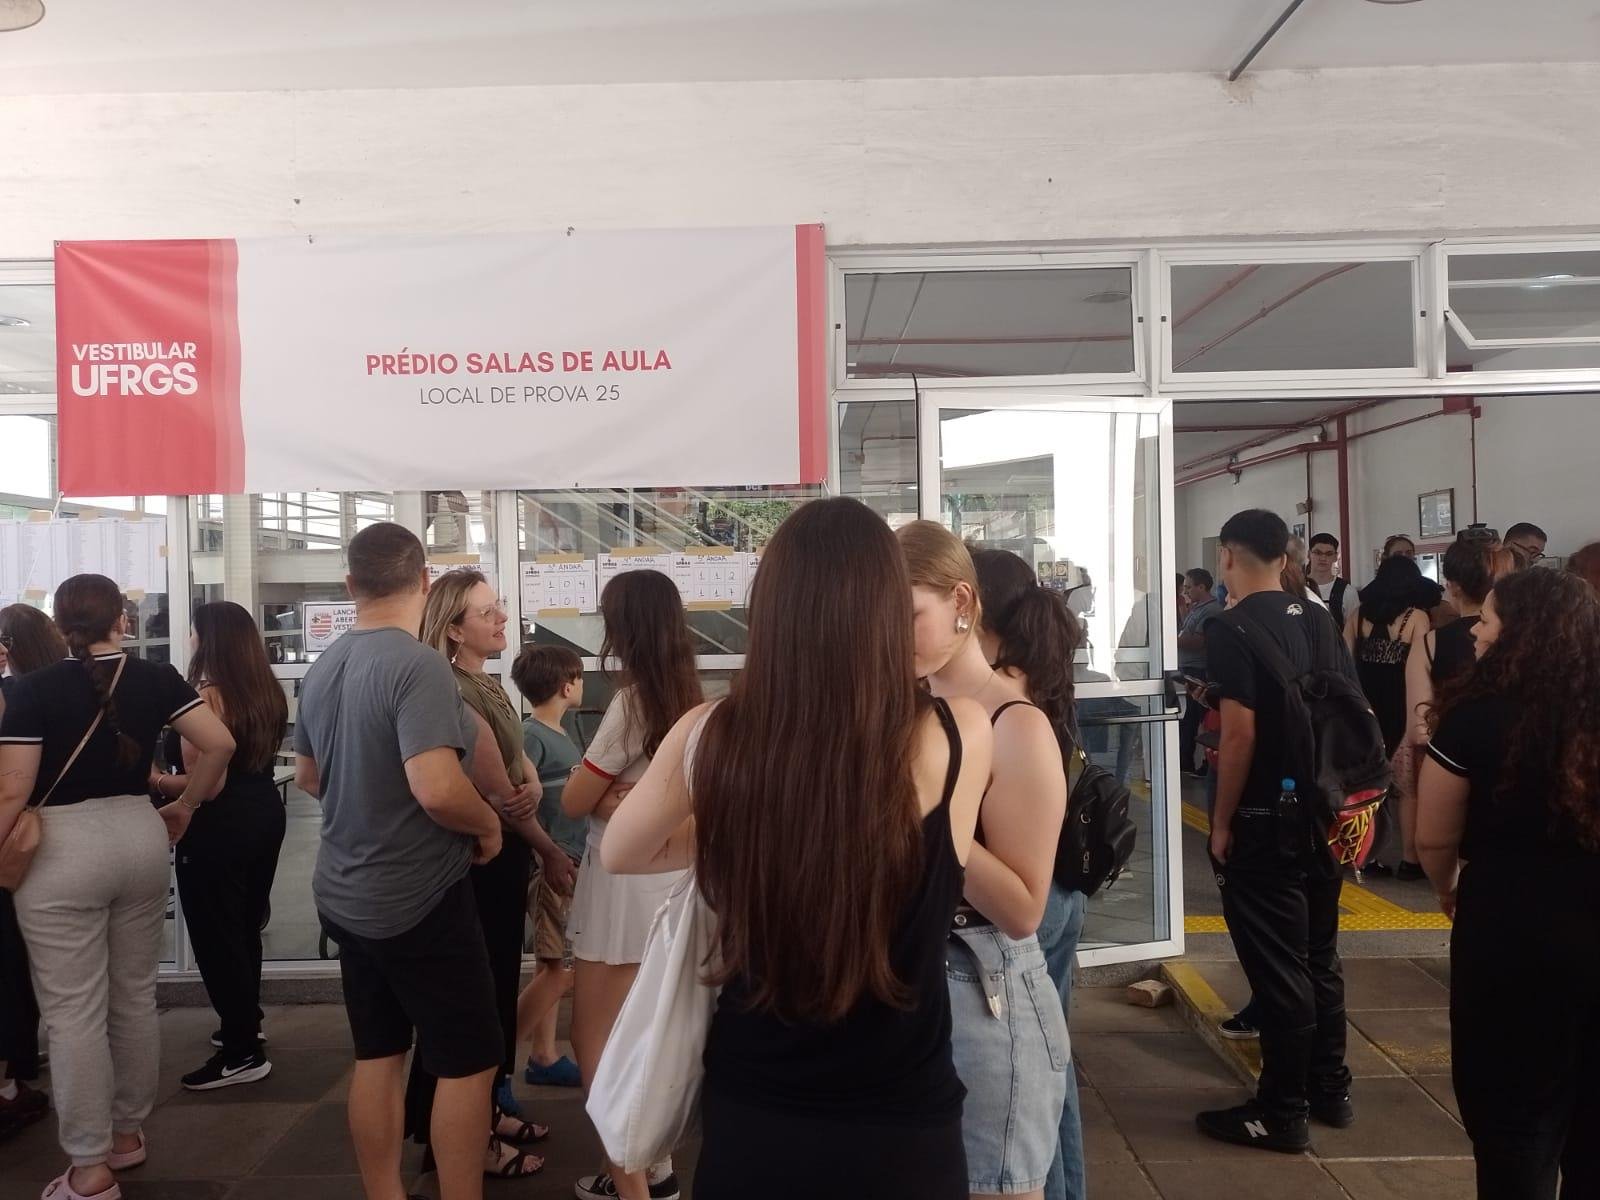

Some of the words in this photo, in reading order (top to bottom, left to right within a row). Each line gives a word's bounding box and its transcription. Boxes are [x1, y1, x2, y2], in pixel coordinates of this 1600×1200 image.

[71, 342, 197, 361] VESTIBULAR
[366, 347, 458, 375] PRÉDIO
[466, 352, 554, 374] SALAS
[562, 351, 593, 372] DE
[601, 350, 672, 371] AULA
[71, 361, 198, 397] UFRGS
[420, 386, 484, 404] LOCAL
[490, 386, 516, 403] DE
[523, 385, 589, 403] PROVA
[595, 384, 620, 401] 25
